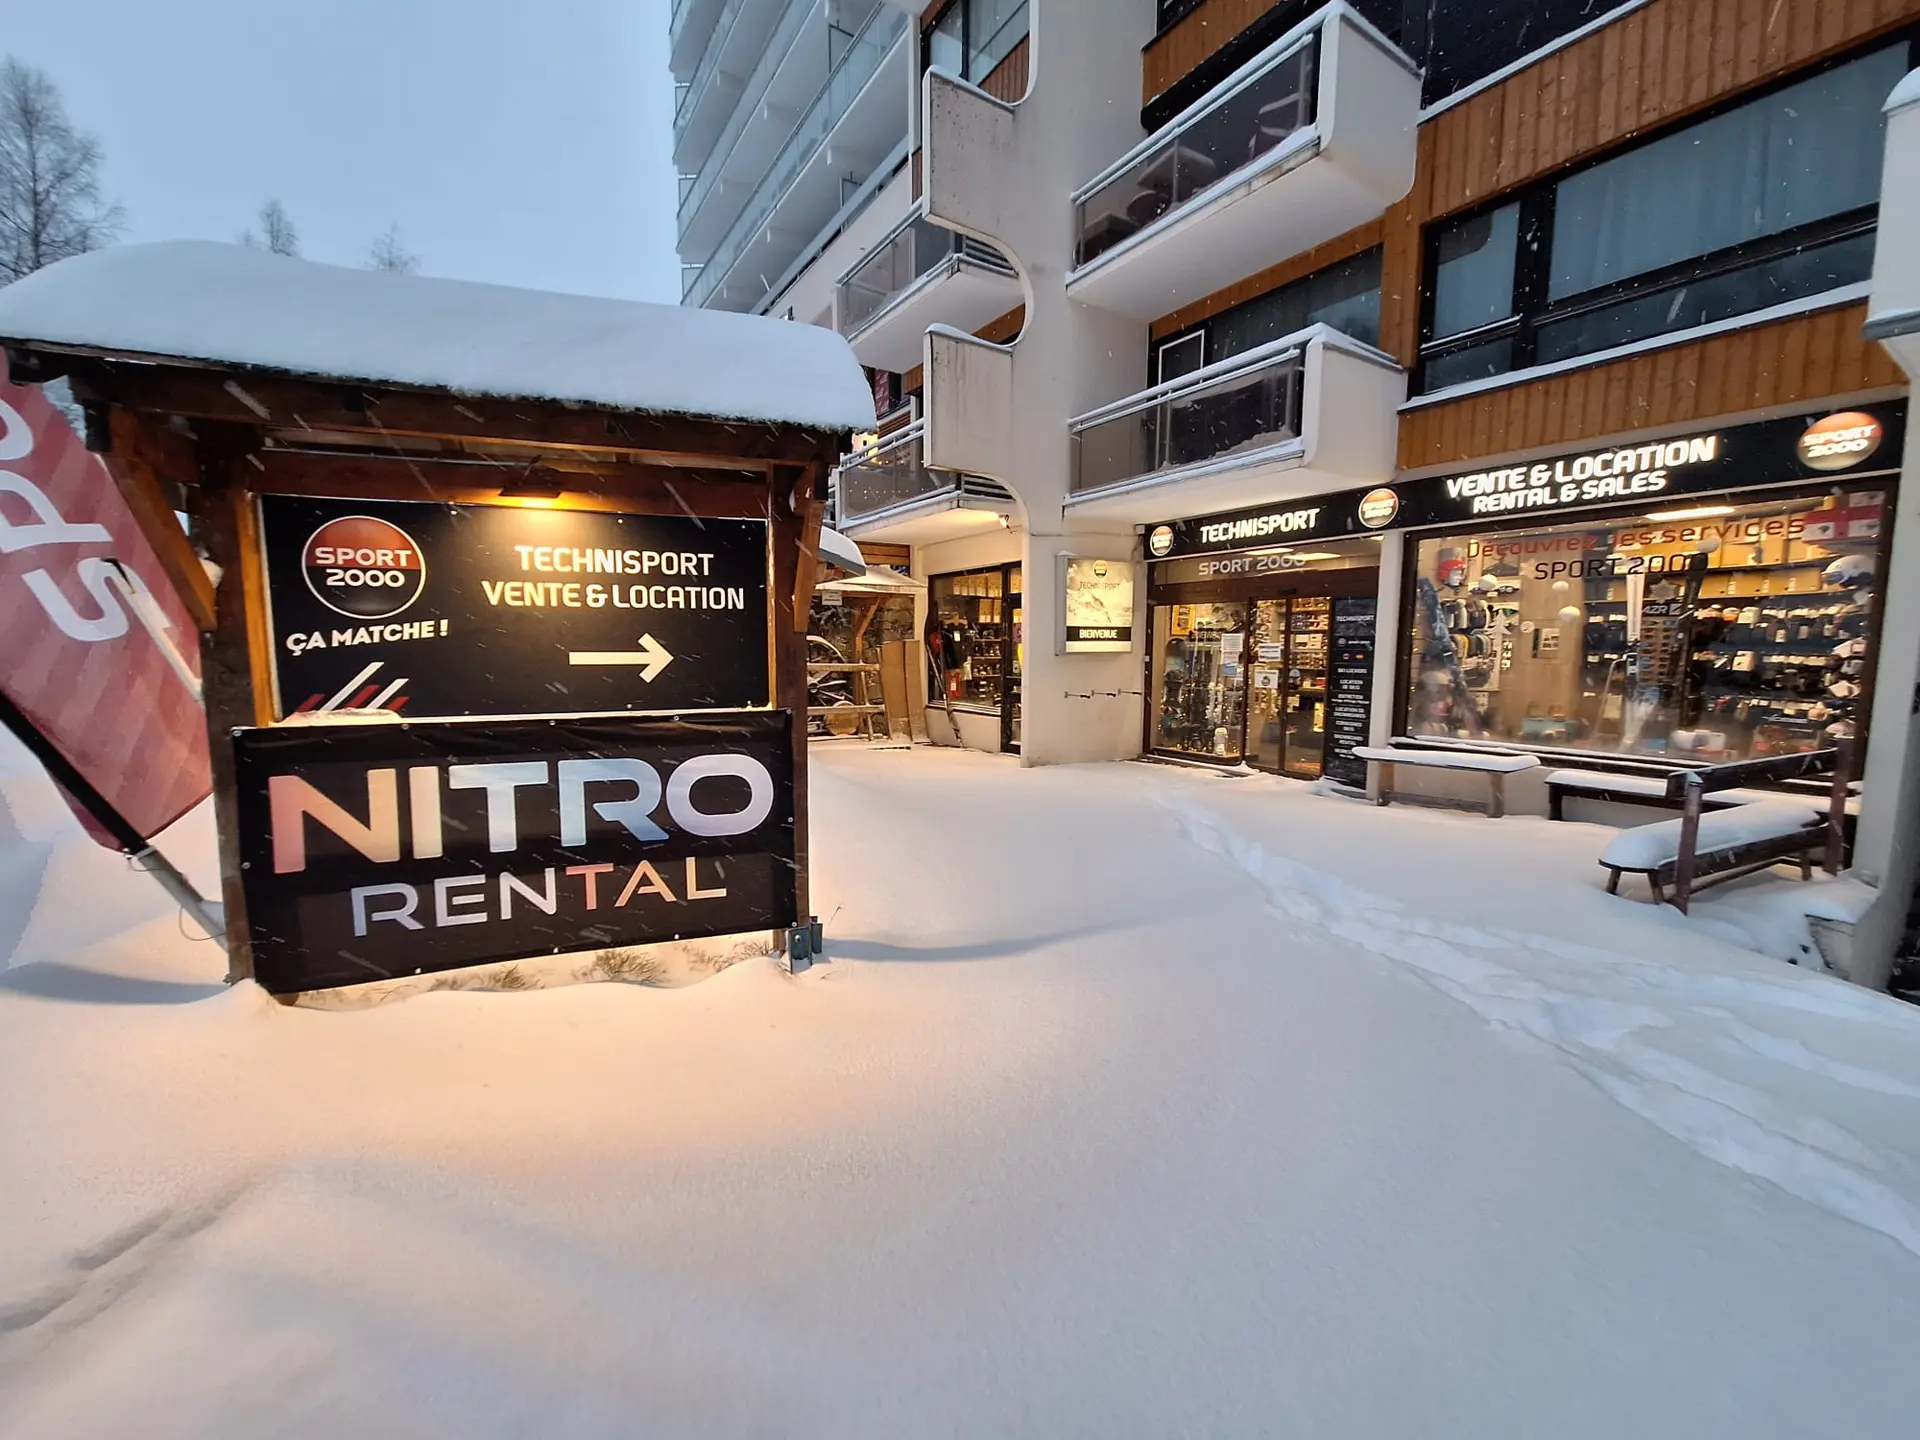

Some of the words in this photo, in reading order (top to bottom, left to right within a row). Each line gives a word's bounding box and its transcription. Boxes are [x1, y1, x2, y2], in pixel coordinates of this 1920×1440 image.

[1803, 424, 1877, 447] SPORT
[1807, 439, 1869, 458] 2000
[1446, 466, 1528, 499] VENTE
[1530, 464, 1552, 487] &
[1554, 435, 1718, 482] LOCATION
[1472, 487, 1558, 514] RENTAL
[1559, 482, 1580, 502] &
[1581, 470, 1668, 500] SALES
[1200, 508, 1320, 544] TECHNISPORT
[1663, 516, 1806, 544] services
[314, 546, 412, 567] SPORT
[514, 544, 715, 576] TECHNISPORT
[1198, 557, 1253, 576] SPORT
[1256, 551, 1306, 571] 2000
[1534, 557, 1618, 581] SPORT
[325, 568, 405, 588] 2000
[481, 580, 581, 608] VENTE
[585, 584, 609, 609] &
[612, 584, 745, 611] LOCATION
[286, 628, 327, 656] ÇA
[331, 622, 435, 648] MATCHE
[1079, 629, 1118, 639] BIENVENUE
[268, 753, 774, 874] NITRO
[353, 856, 728, 937] RENTAL
